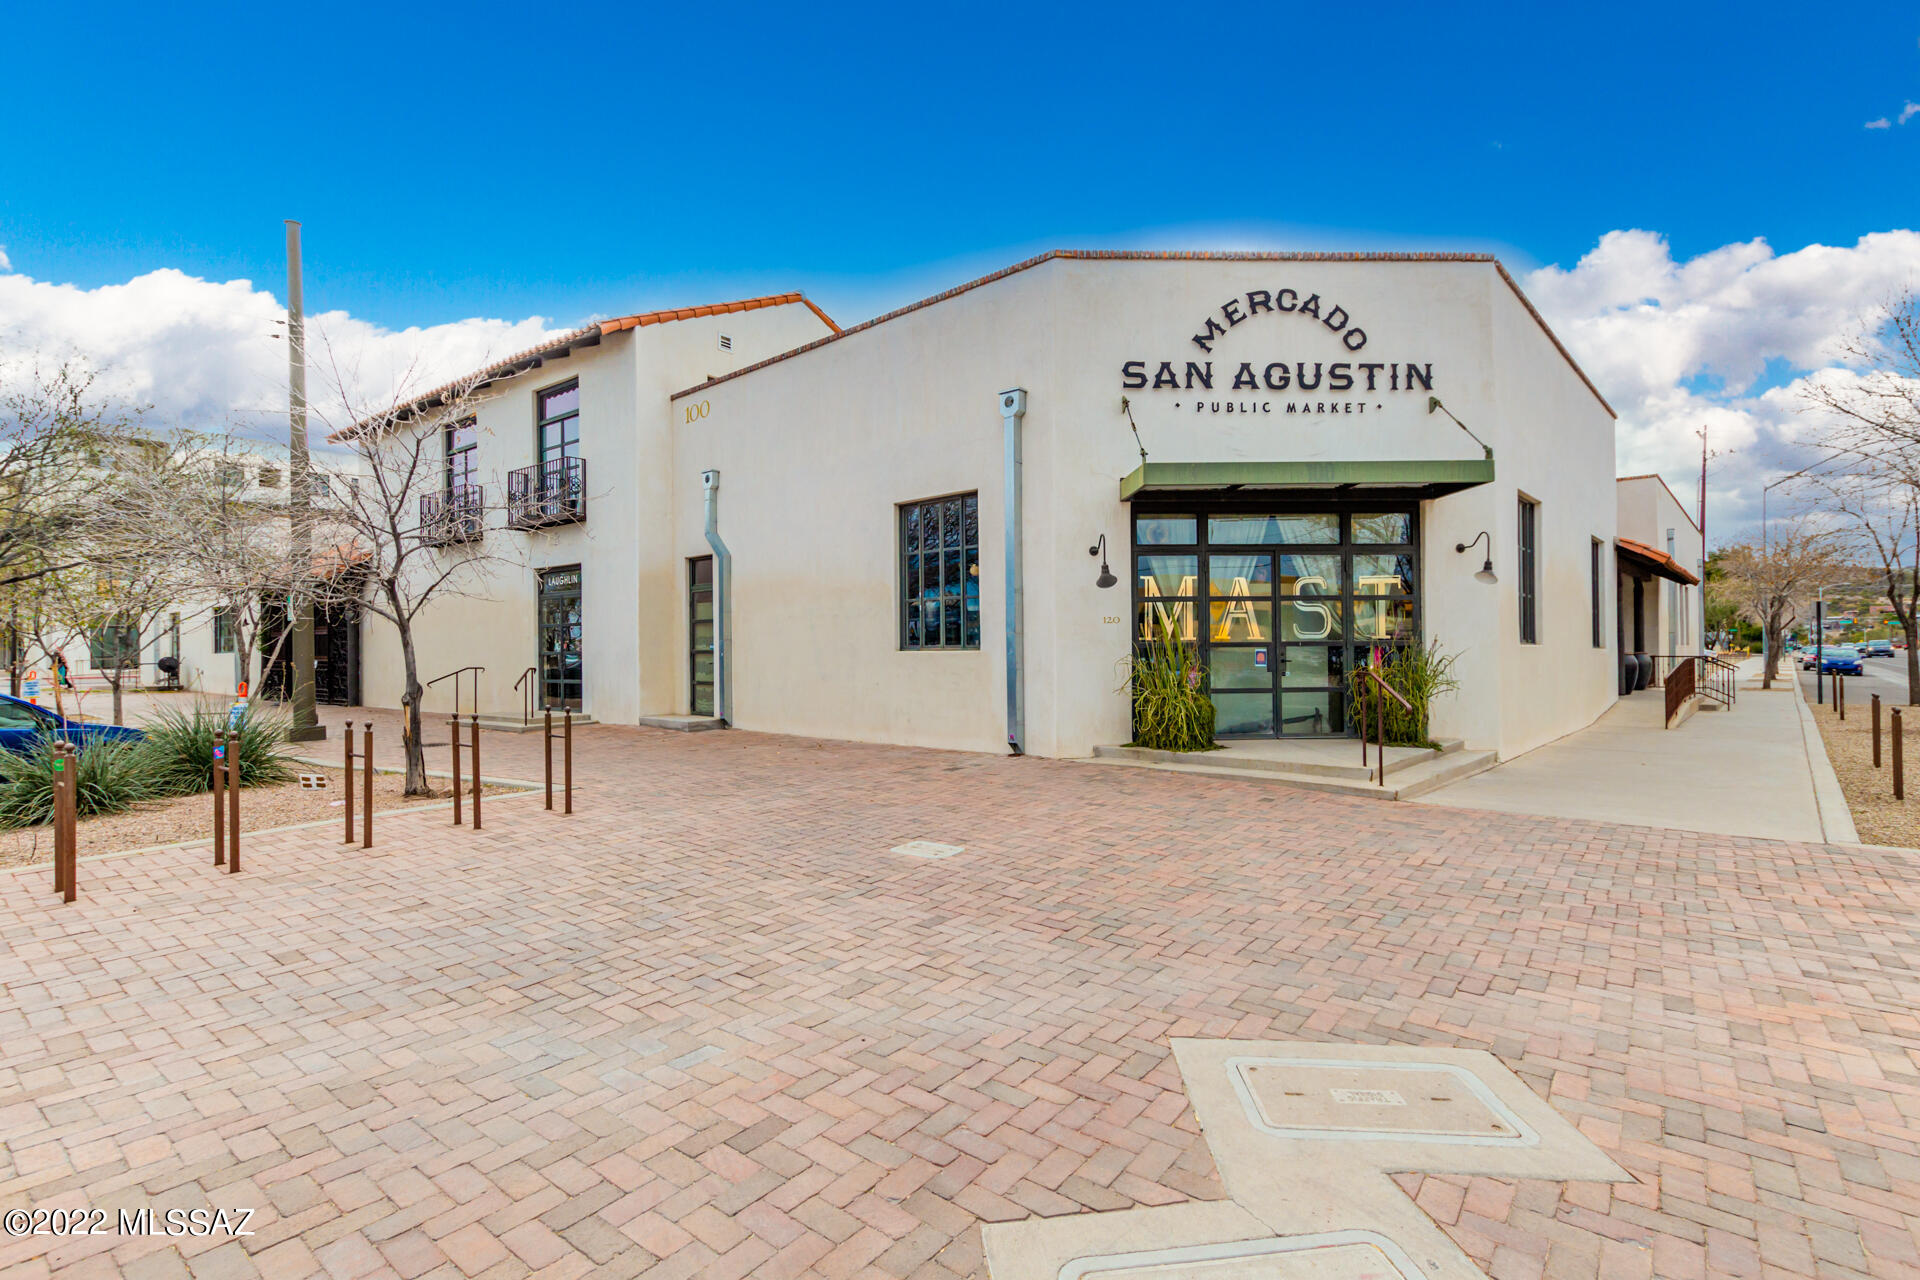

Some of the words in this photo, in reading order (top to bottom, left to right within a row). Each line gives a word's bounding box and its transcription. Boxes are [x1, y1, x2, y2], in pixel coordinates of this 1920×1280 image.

[1191, 288, 1368, 354] MERCADO
[1121, 361, 1214, 390] SAN
[1231, 362, 1434, 391] AGUSTIN
[685, 399, 711, 425] 100
[1196, 401, 1272, 414] PUBLIC
[1286, 402, 1368, 414] MARKET
[548, 574, 578, 586] LAUGHLIN
[1103, 616, 1121, 625] 120
[1138, 574, 1402, 641] MAST
